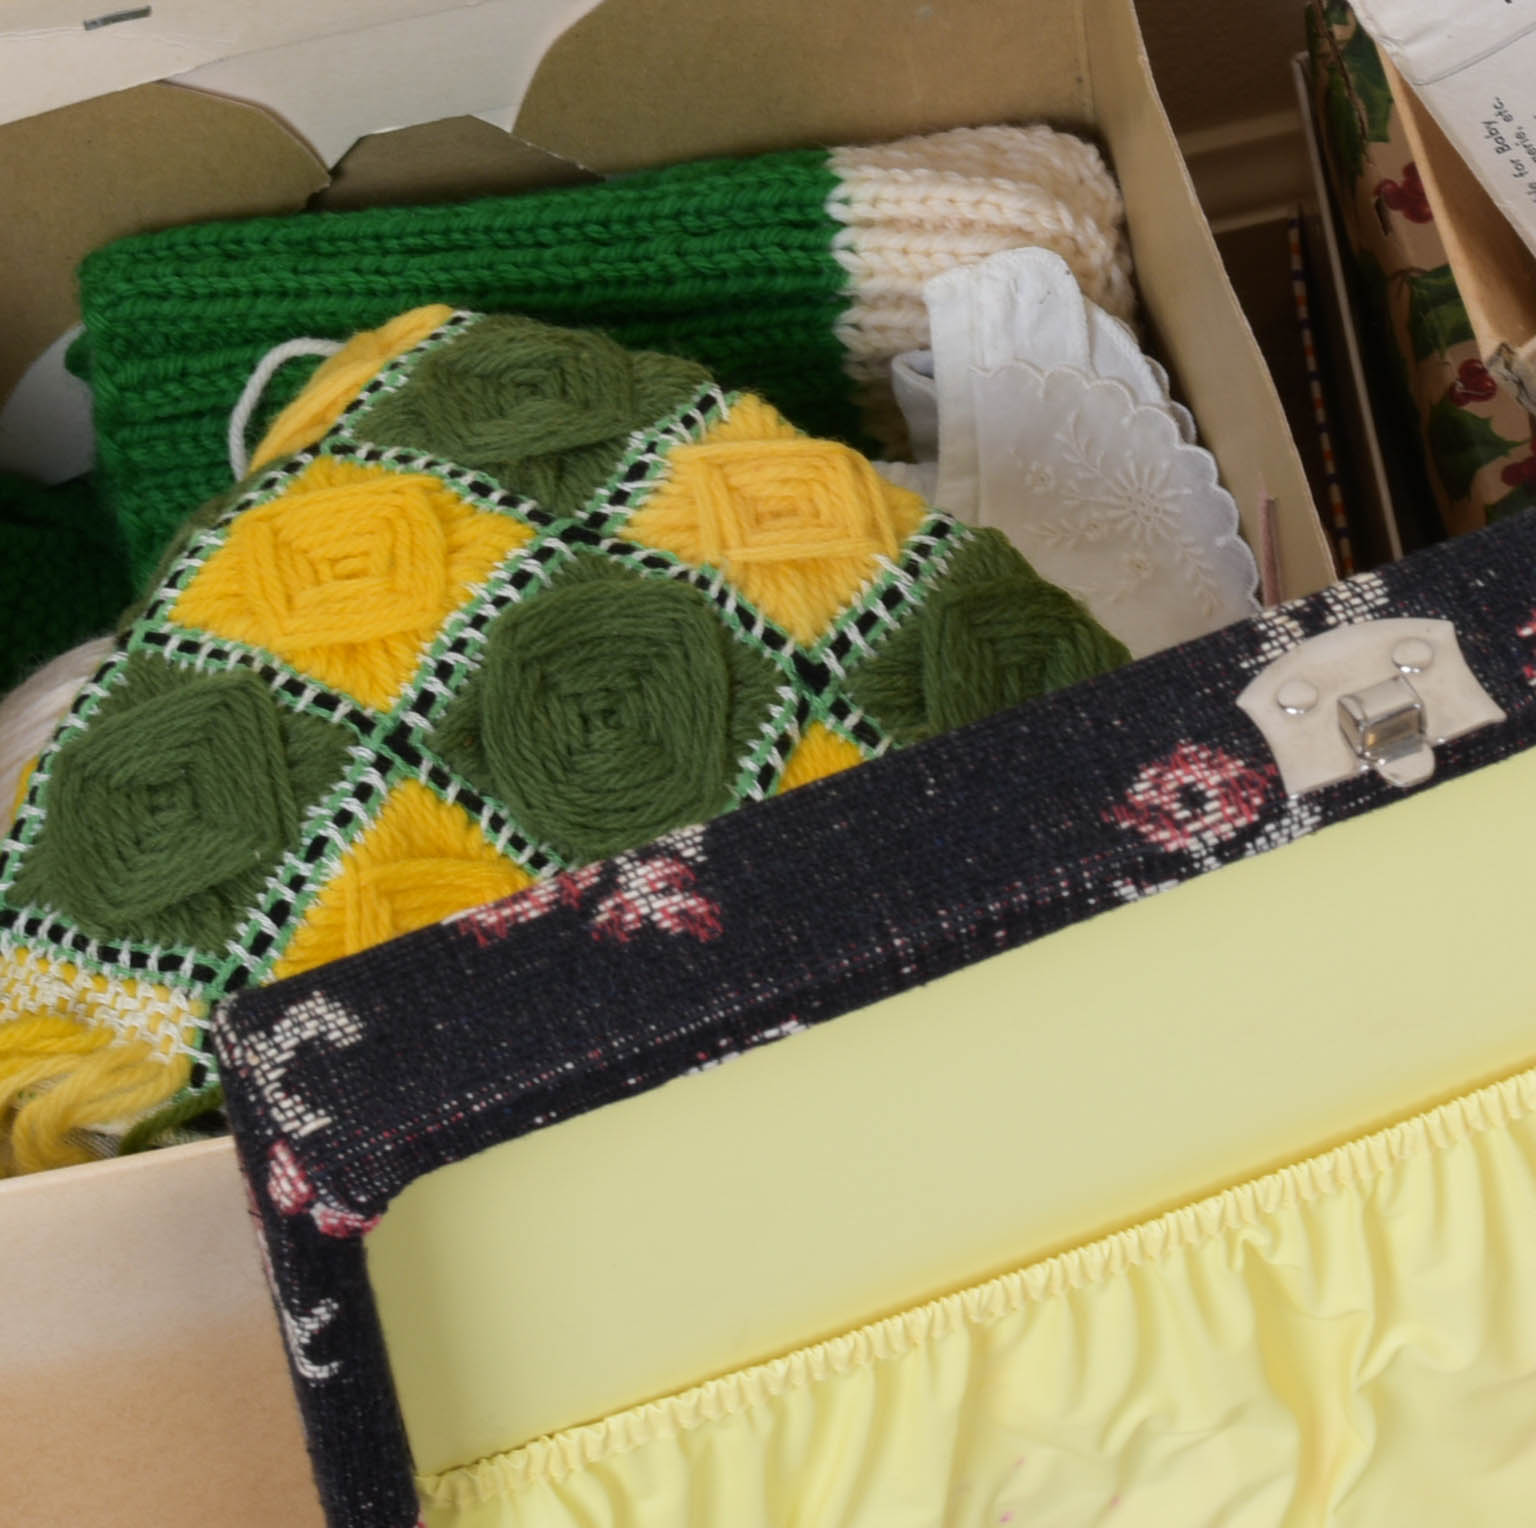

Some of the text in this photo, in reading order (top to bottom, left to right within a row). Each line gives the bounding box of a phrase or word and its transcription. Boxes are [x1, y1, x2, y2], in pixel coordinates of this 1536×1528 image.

[1492, 96, 1514, 122] etc.
[1480, 120, 1512, 155] Baby
[1509, 158, 1529, 178] for
